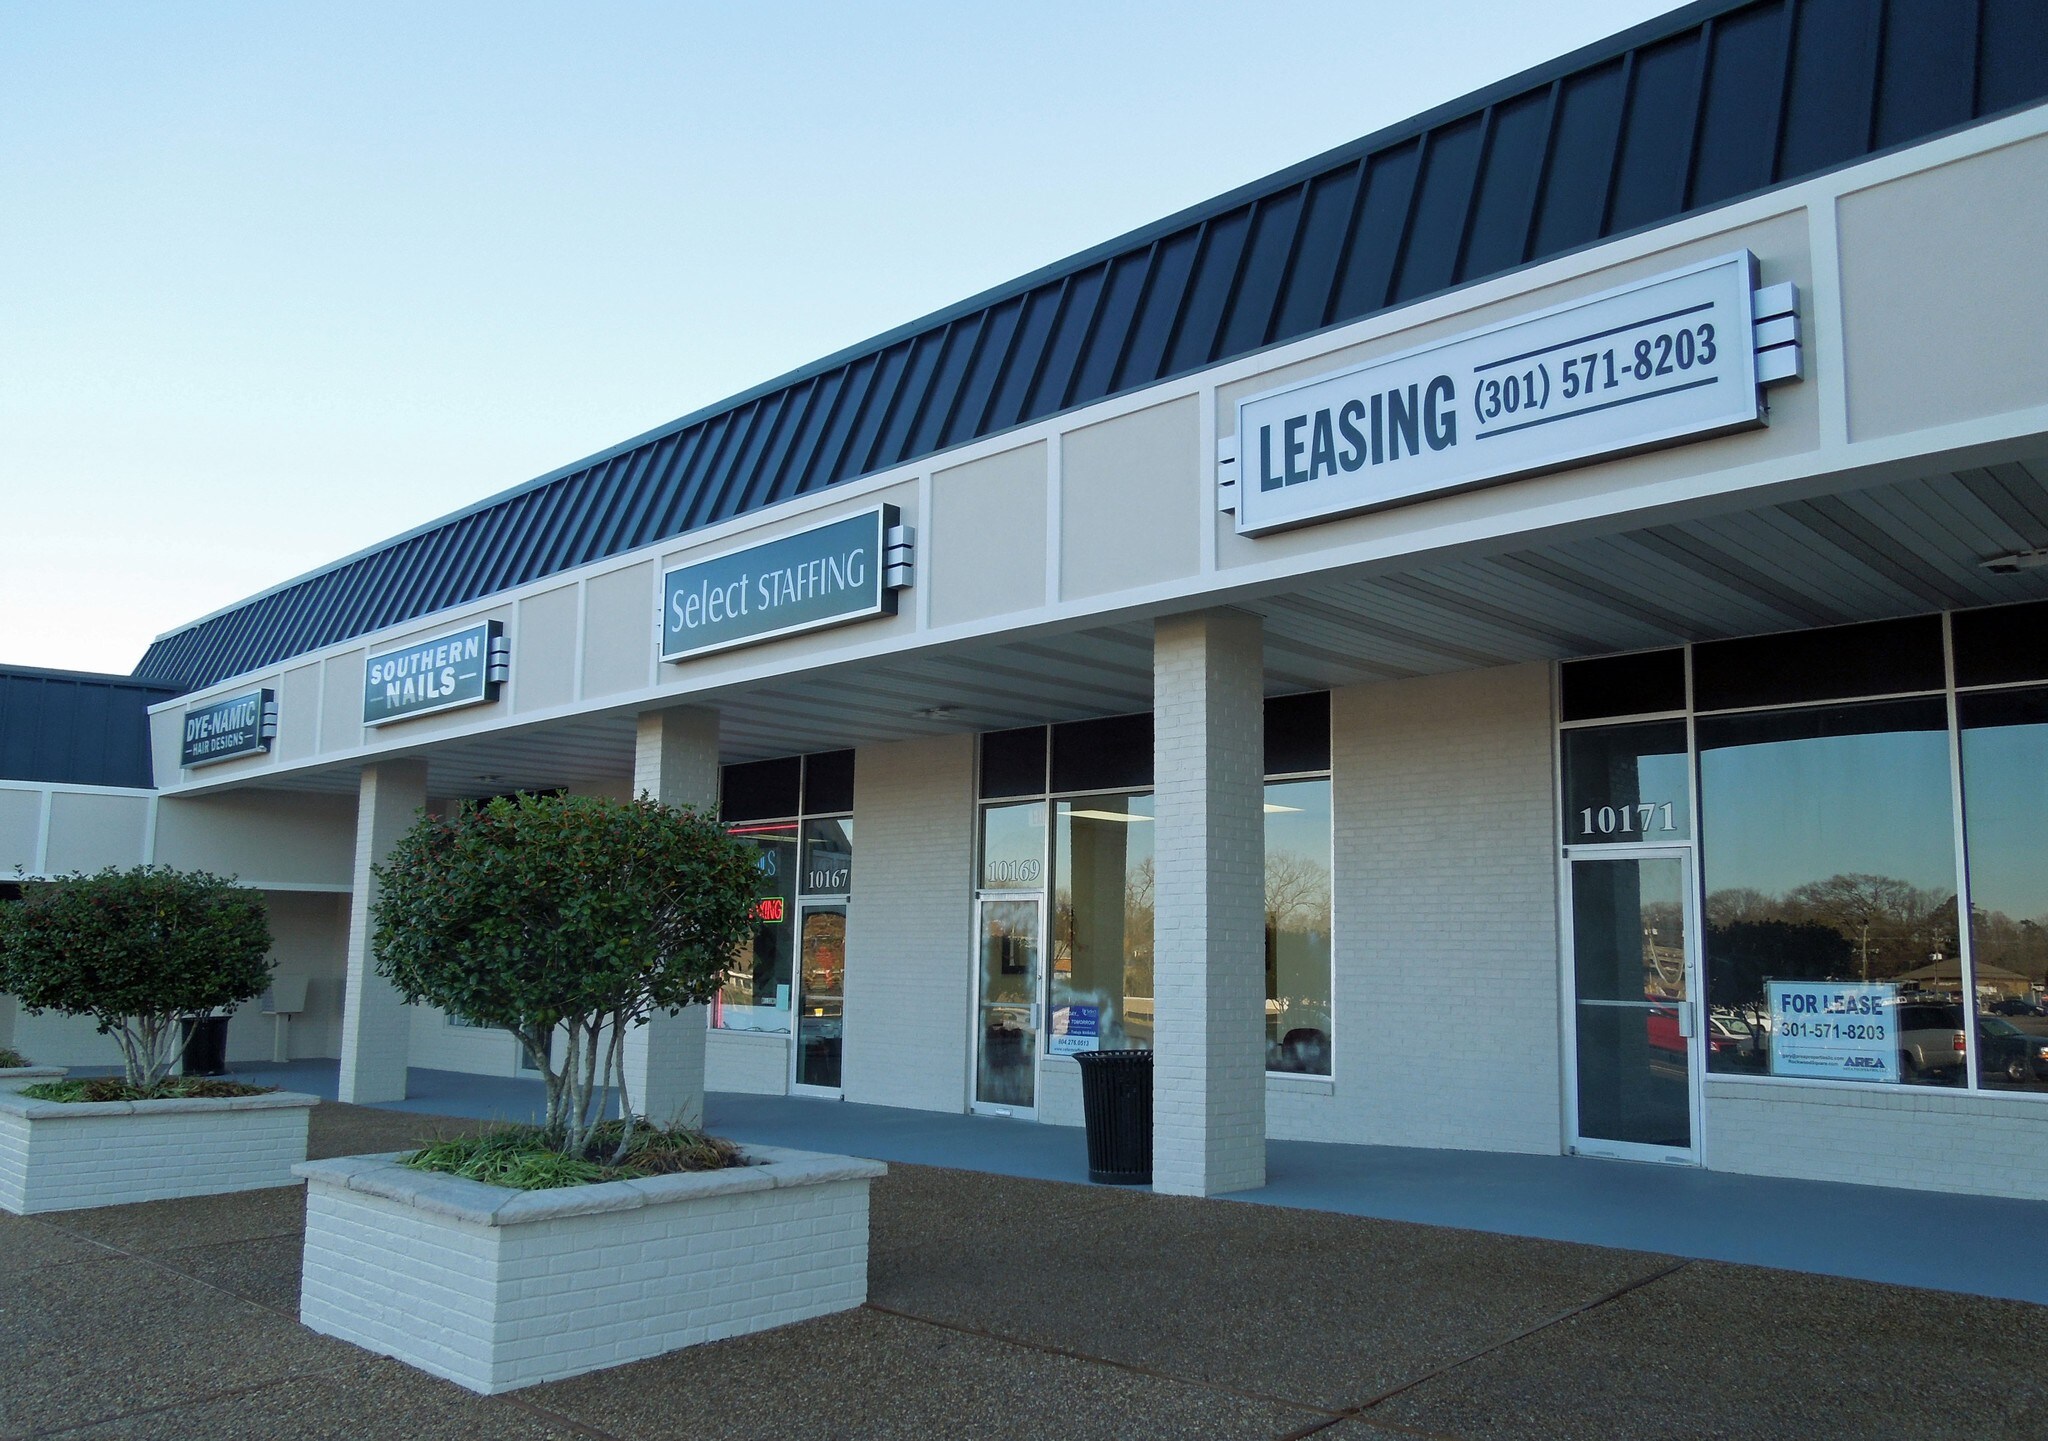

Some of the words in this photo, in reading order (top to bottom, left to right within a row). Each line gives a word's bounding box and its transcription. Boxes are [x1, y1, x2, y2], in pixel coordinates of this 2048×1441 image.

[1260, 374, 1457, 492] LEASING
[1473, 362, 1550, 425] (301)
[1562, 322, 1717, 399] 571-8203
[671, 573, 749, 633] Select
[758, 548, 864, 611] STAFFING
[370, 636, 479, 685] SOUTHERN
[386, 667, 456, 709] NAILS
[186, 701, 256, 742] DYE-NAMIC
[192, 740, 210, 756] HAIR
[211, 731, 244, 751] DESIGNS
[1579, 802, 1677, 835] 10171
[808, 869, 849, 889] 10167
[988, 859, 1041, 883] 10169
[1781, 993, 1818, 1014] FOR
[1823, 994, 1883, 1016] LEASE
[1781, 1022, 1885, 1041] 301-571-8203
[1843, 1056, 1886, 1069] AREA
